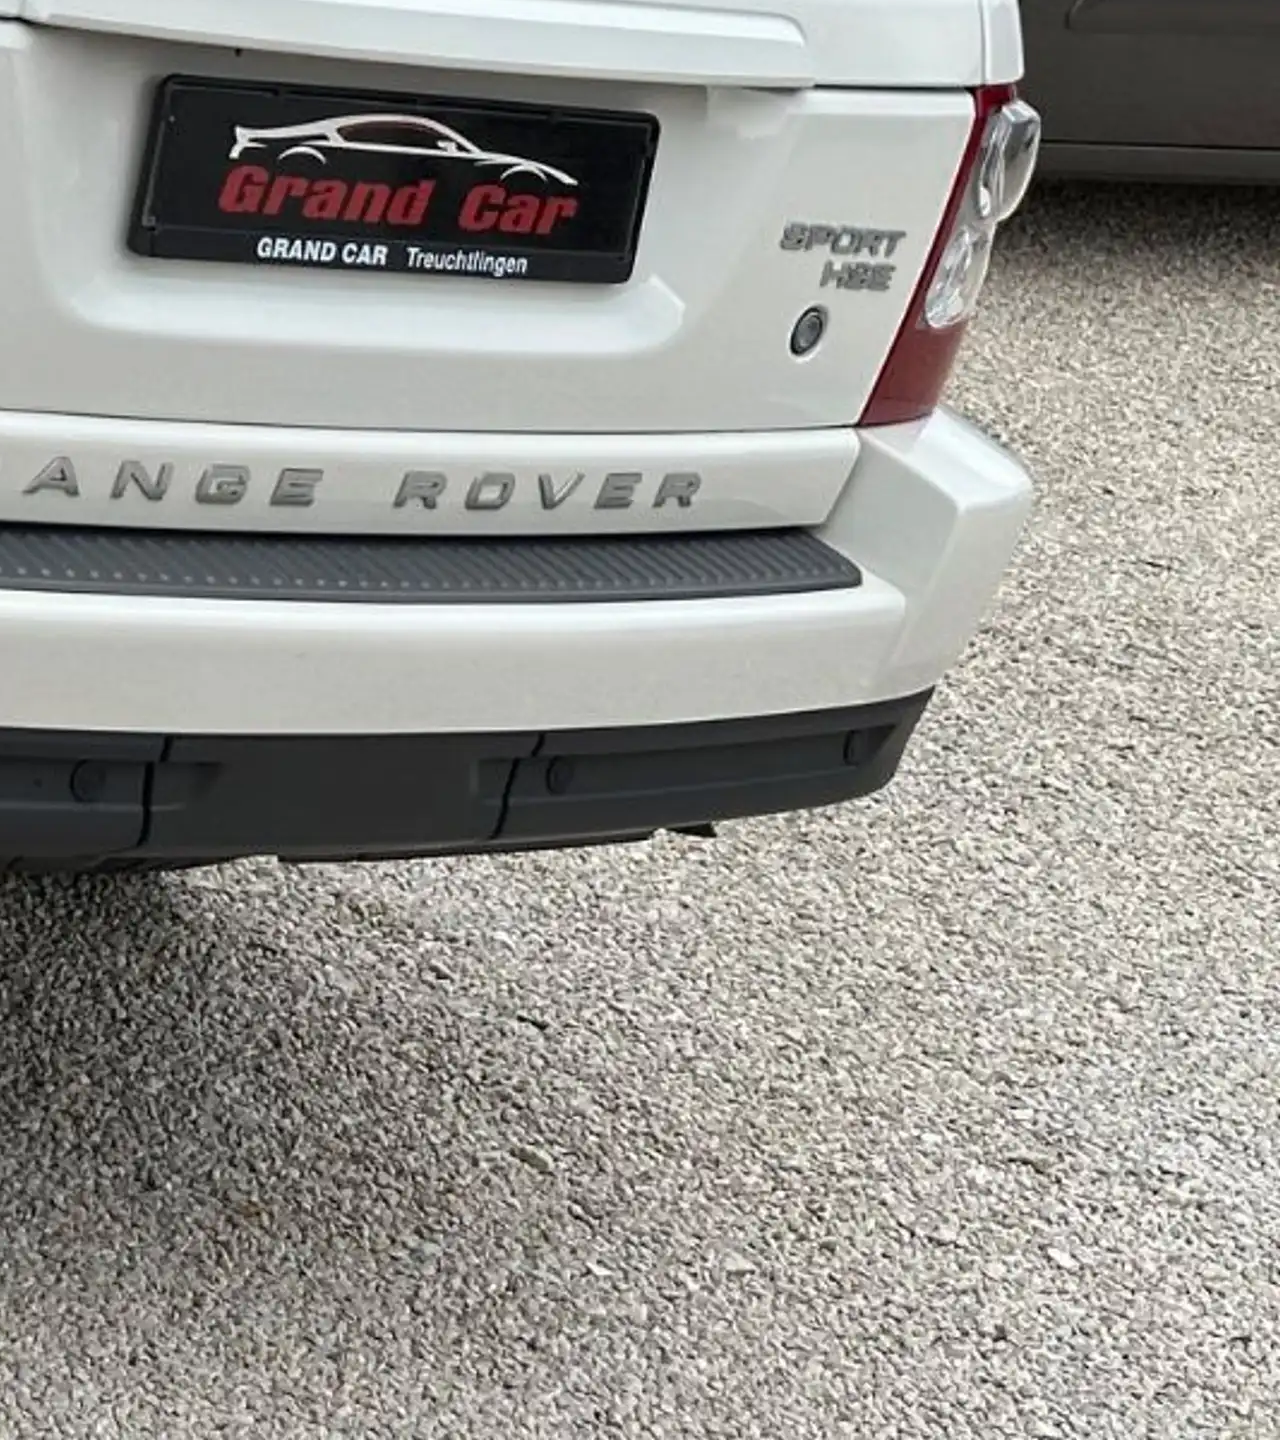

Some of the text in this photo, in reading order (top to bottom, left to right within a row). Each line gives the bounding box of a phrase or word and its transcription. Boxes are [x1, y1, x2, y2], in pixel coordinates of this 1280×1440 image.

[217, 164, 579, 235] Grand Car
[256, 236, 529, 278] GRAND CAR Treuchtlingen
[779, 223, 908, 258] SPORT
[818, 260, 897, 292] HSE
[393, 469, 704, 512] ROVER
